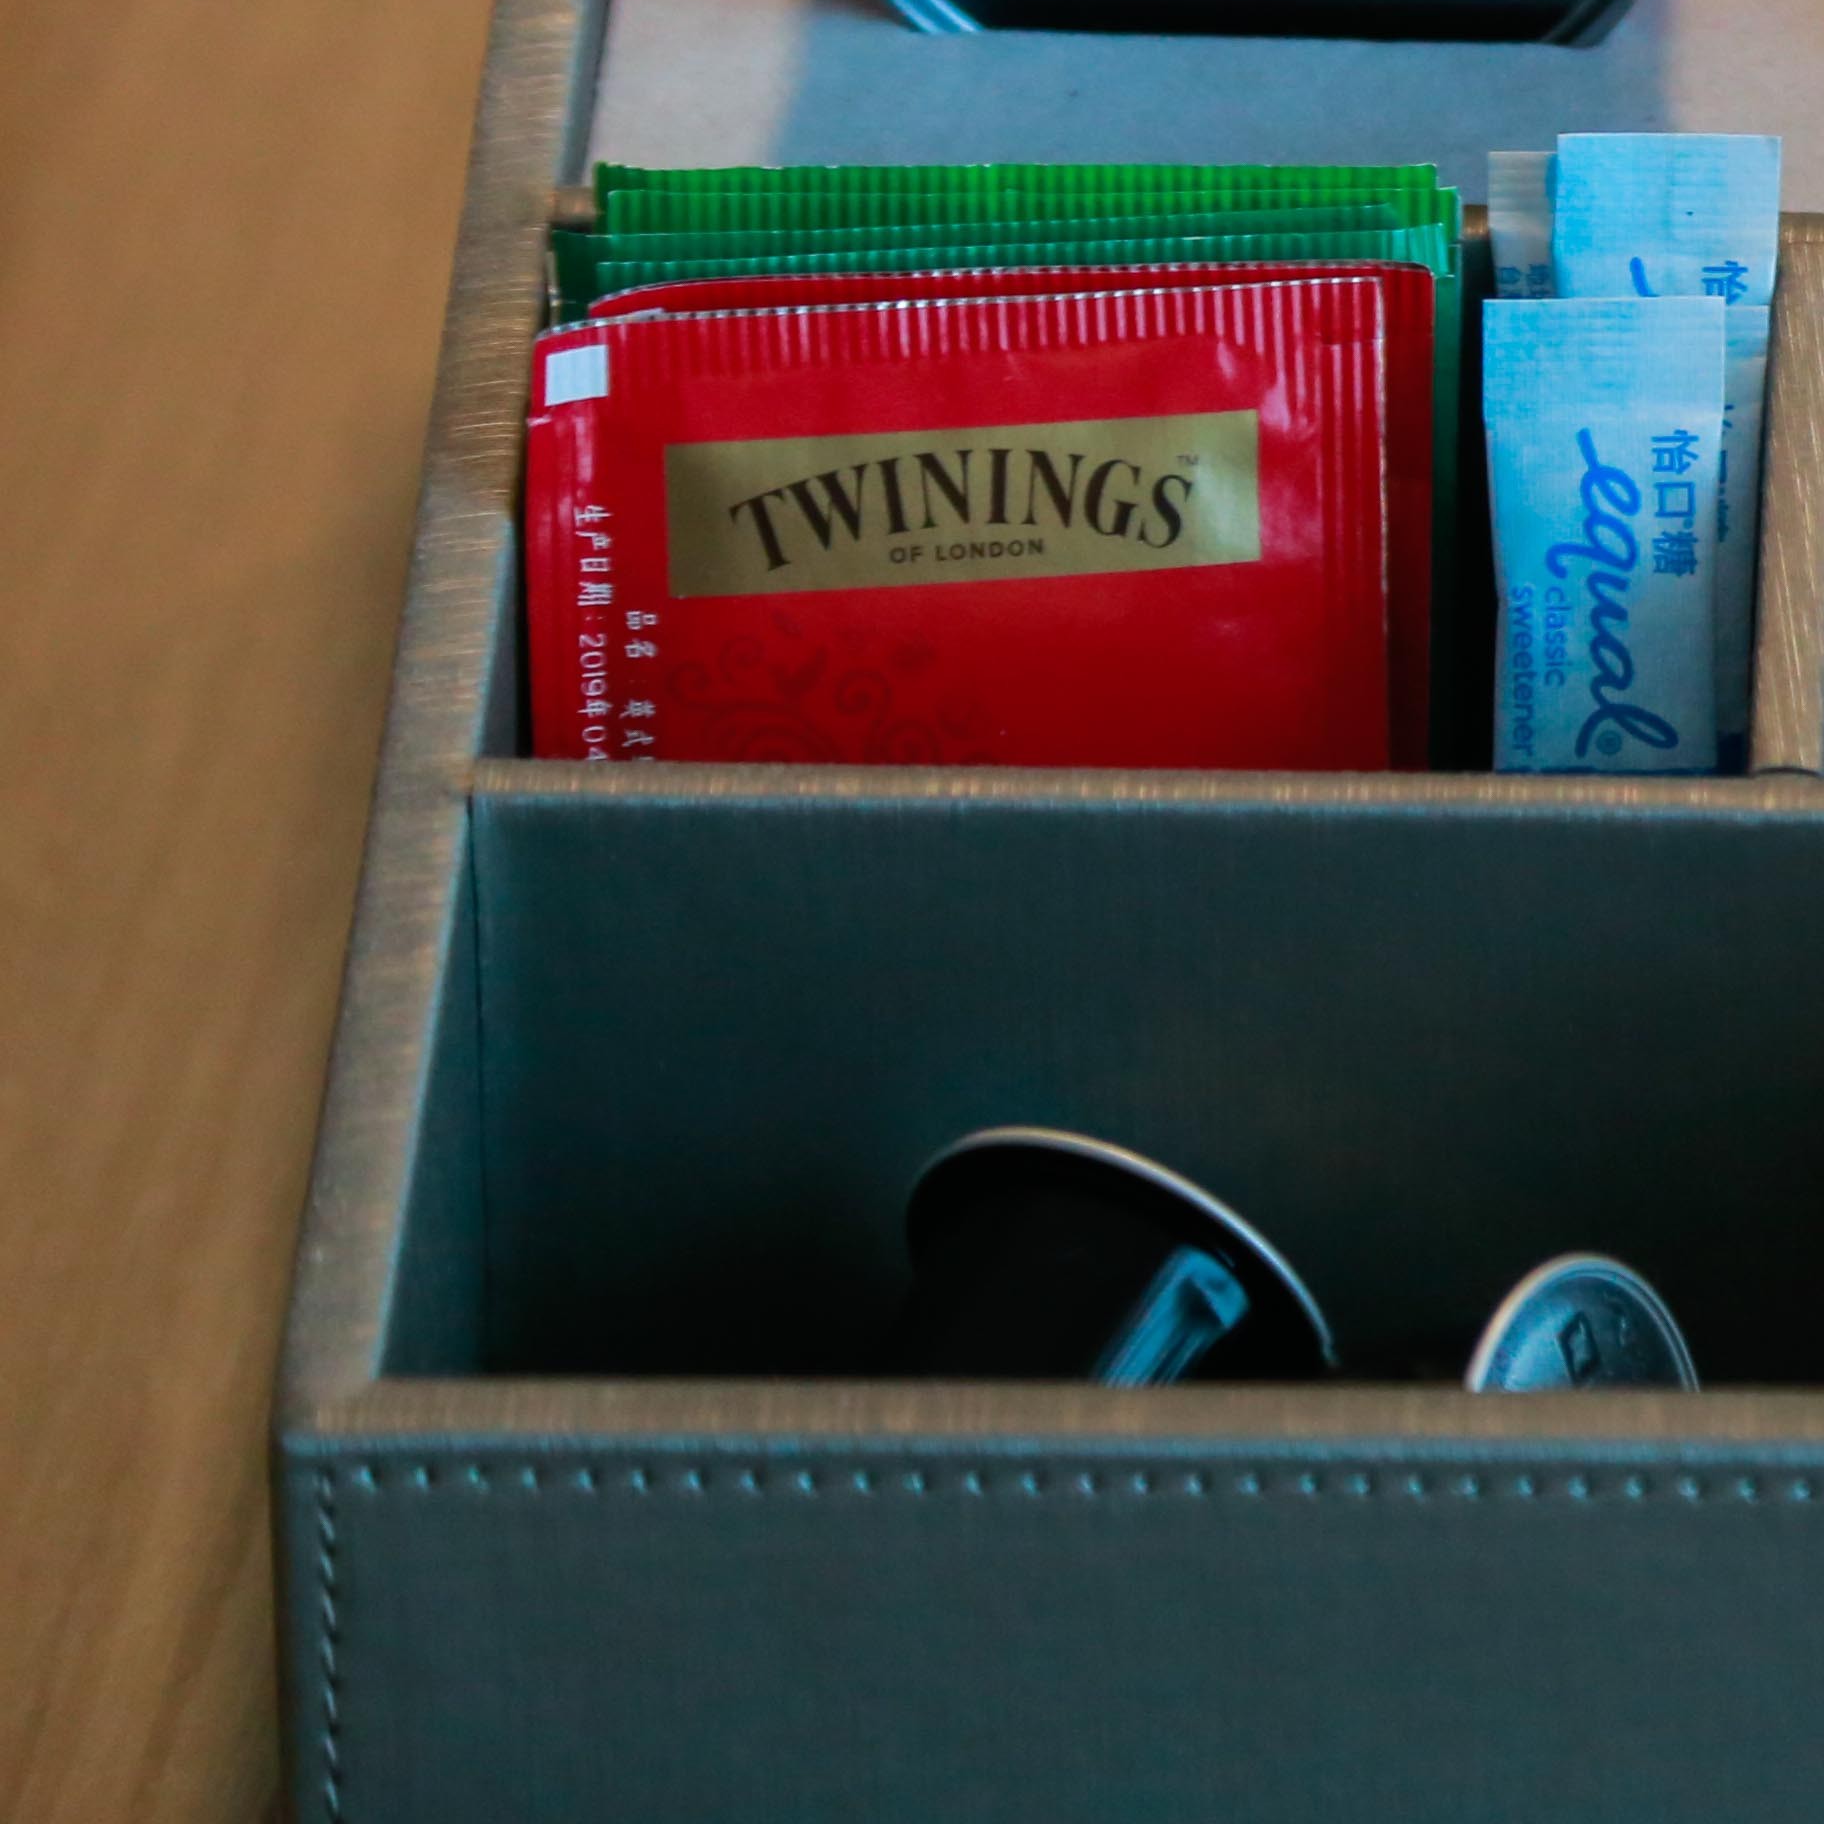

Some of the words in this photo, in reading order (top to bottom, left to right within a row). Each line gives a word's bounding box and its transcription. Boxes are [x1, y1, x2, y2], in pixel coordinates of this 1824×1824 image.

[729, 448, 1194, 572] TWININGS
[888, 546, 925, 565] OF
[935, 538, 1046, 562] LONDON
[1650, 428, 1700, 577] 怡口糖
[1542, 585, 1569, 688] classic
[1544, 427, 1680, 760] equal
[1508, 584, 1538, 758] sweetener
